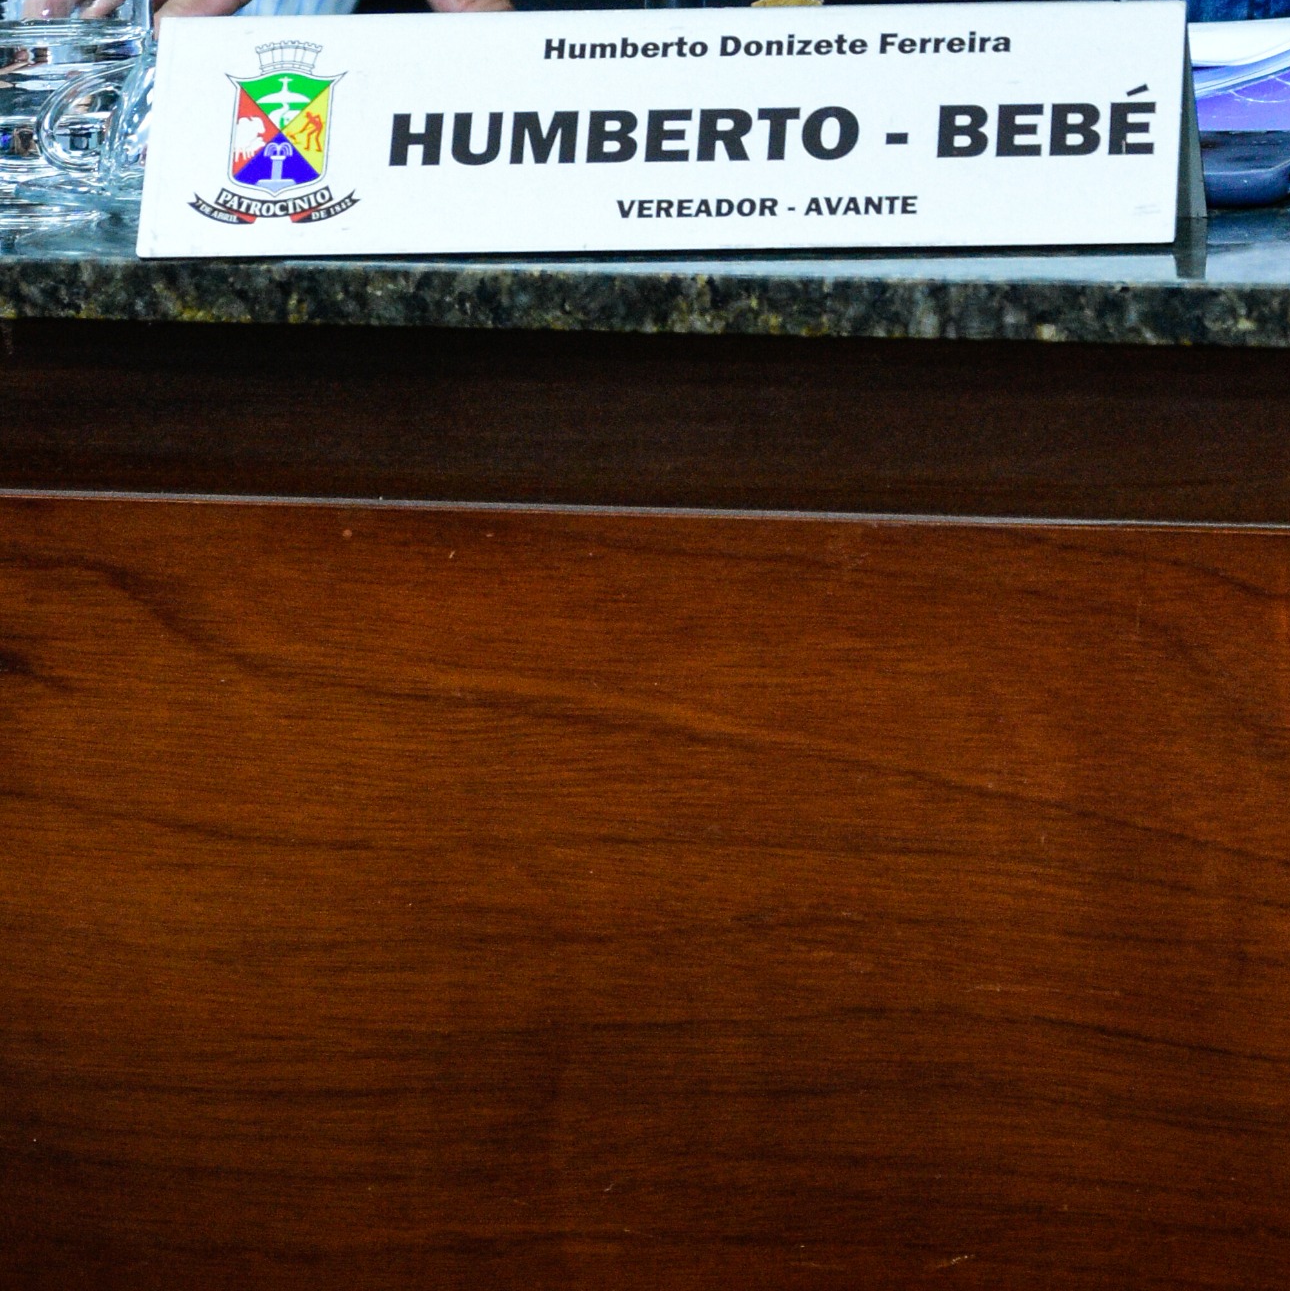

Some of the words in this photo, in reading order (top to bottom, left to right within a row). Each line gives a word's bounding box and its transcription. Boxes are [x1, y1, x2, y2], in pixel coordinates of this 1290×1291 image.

[545, 37, 708, 60] Humberto
[721, 34, 868, 57] Donizete
[879, 33, 1011, 54] Ferreira
[389, 106, 859, 166] HUMBERTO
[886, 132, 909, 145] -
[937, 84, 1156, 158] BEBÉ
[200, 203, 212, 214] DE
[311, 208, 328, 221] DE
[216, 188, 331, 217] PATROCÍNIO
[617, 198, 778, 219] VEREADOR
[804, 195, 918, 216] AVANTE
